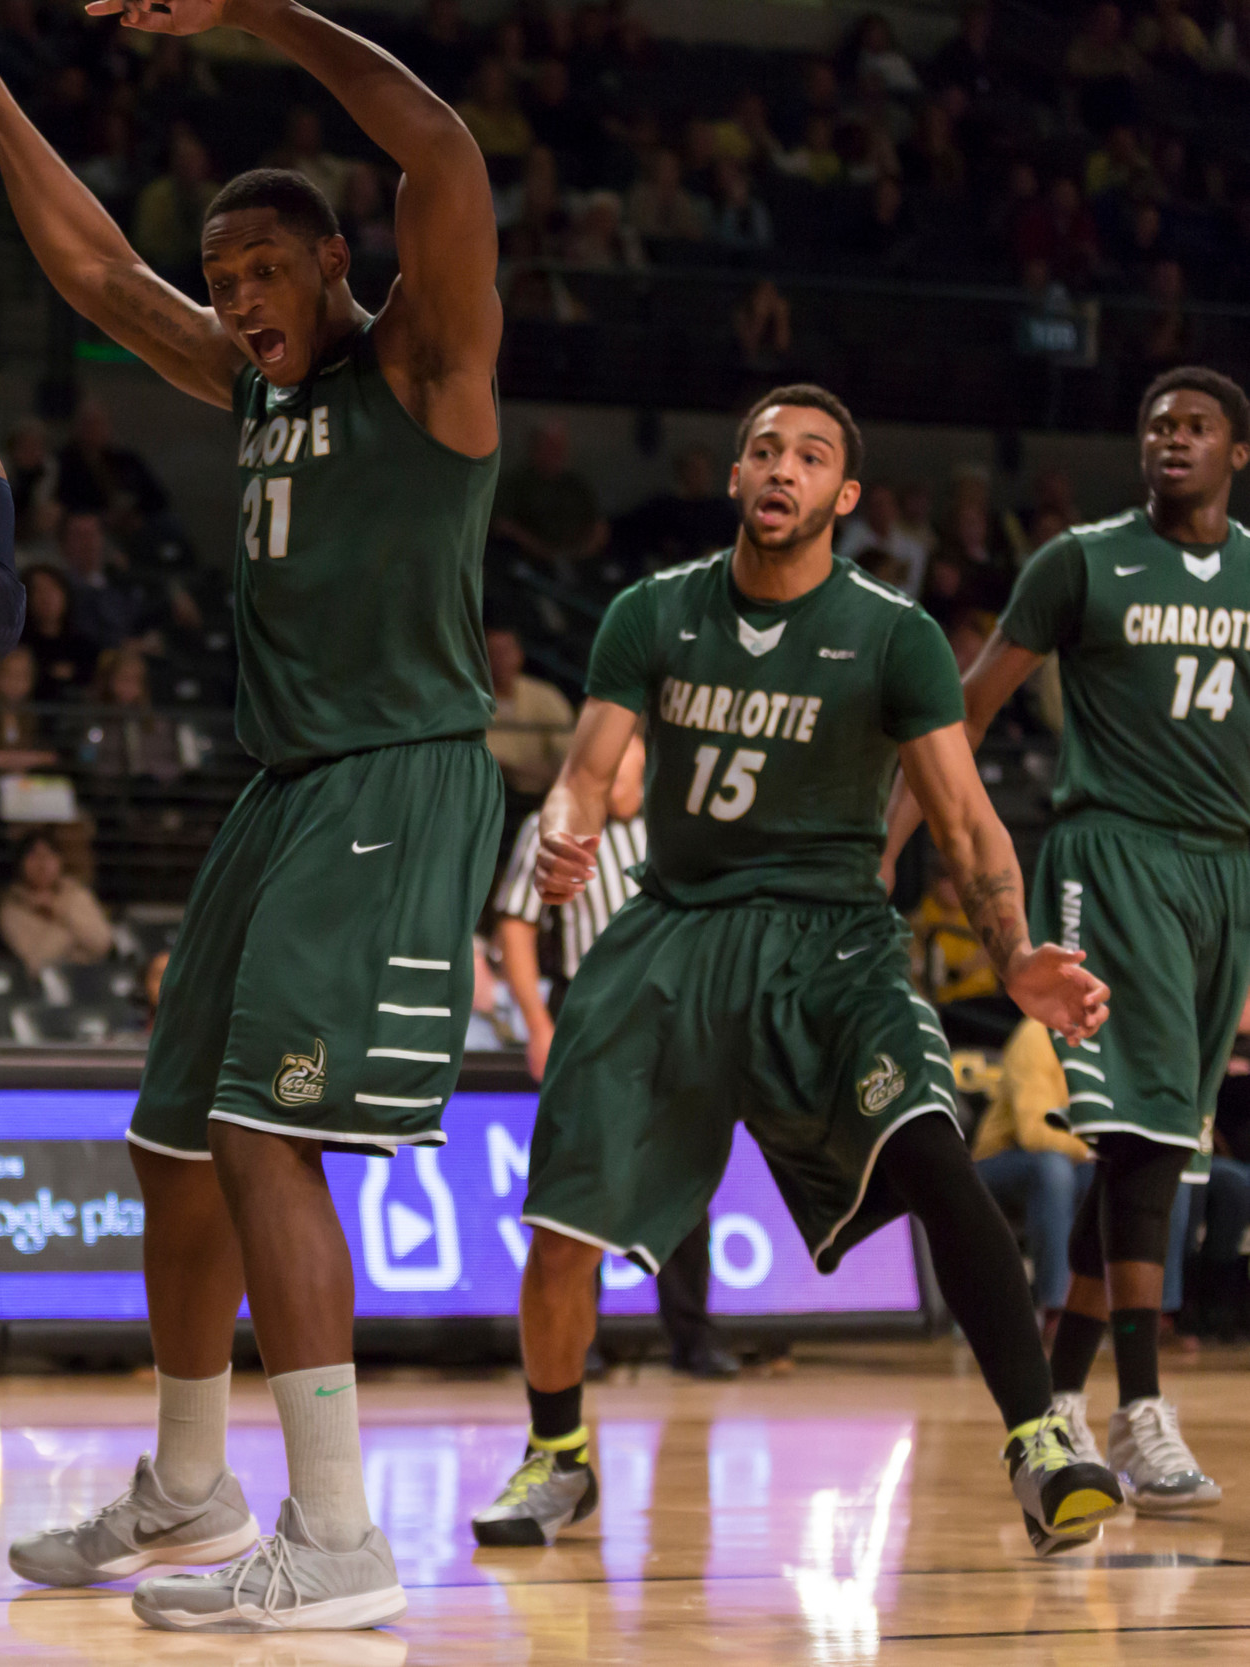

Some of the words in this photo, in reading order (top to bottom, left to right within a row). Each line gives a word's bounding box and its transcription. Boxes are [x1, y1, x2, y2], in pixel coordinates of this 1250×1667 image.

[242, 475, 292, 561] 21
[659, 675, 823, 744] CHARLOTTE
[1170, 655, 1236, 722] 14
[685, 744, 768, 822] 15
